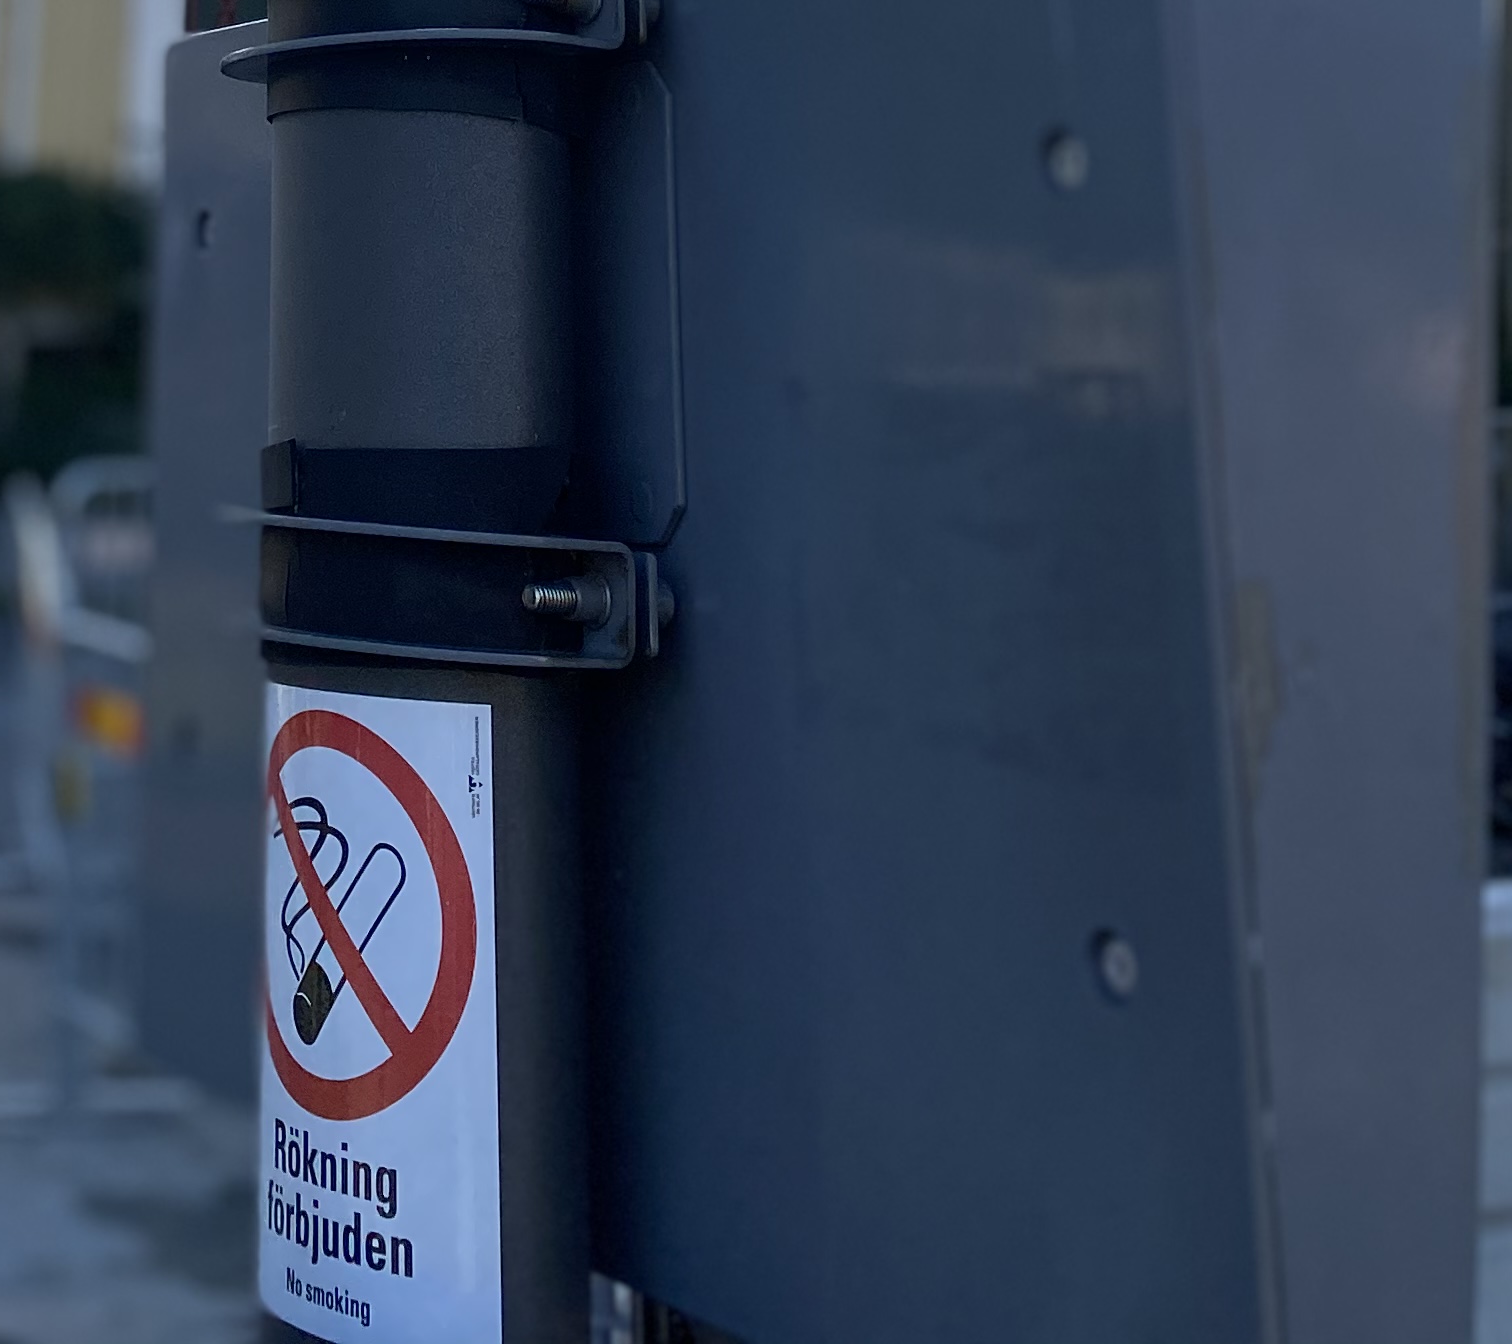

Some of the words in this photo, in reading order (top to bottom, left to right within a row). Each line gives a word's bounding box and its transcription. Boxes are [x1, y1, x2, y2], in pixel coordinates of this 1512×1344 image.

[274, 1118, 398, 1219] Rökning
[267, 1179, 414, 1279] förbjuden
[286, 1267, 303, 1297] No
[305, 1286, 371, 1328] smoking
